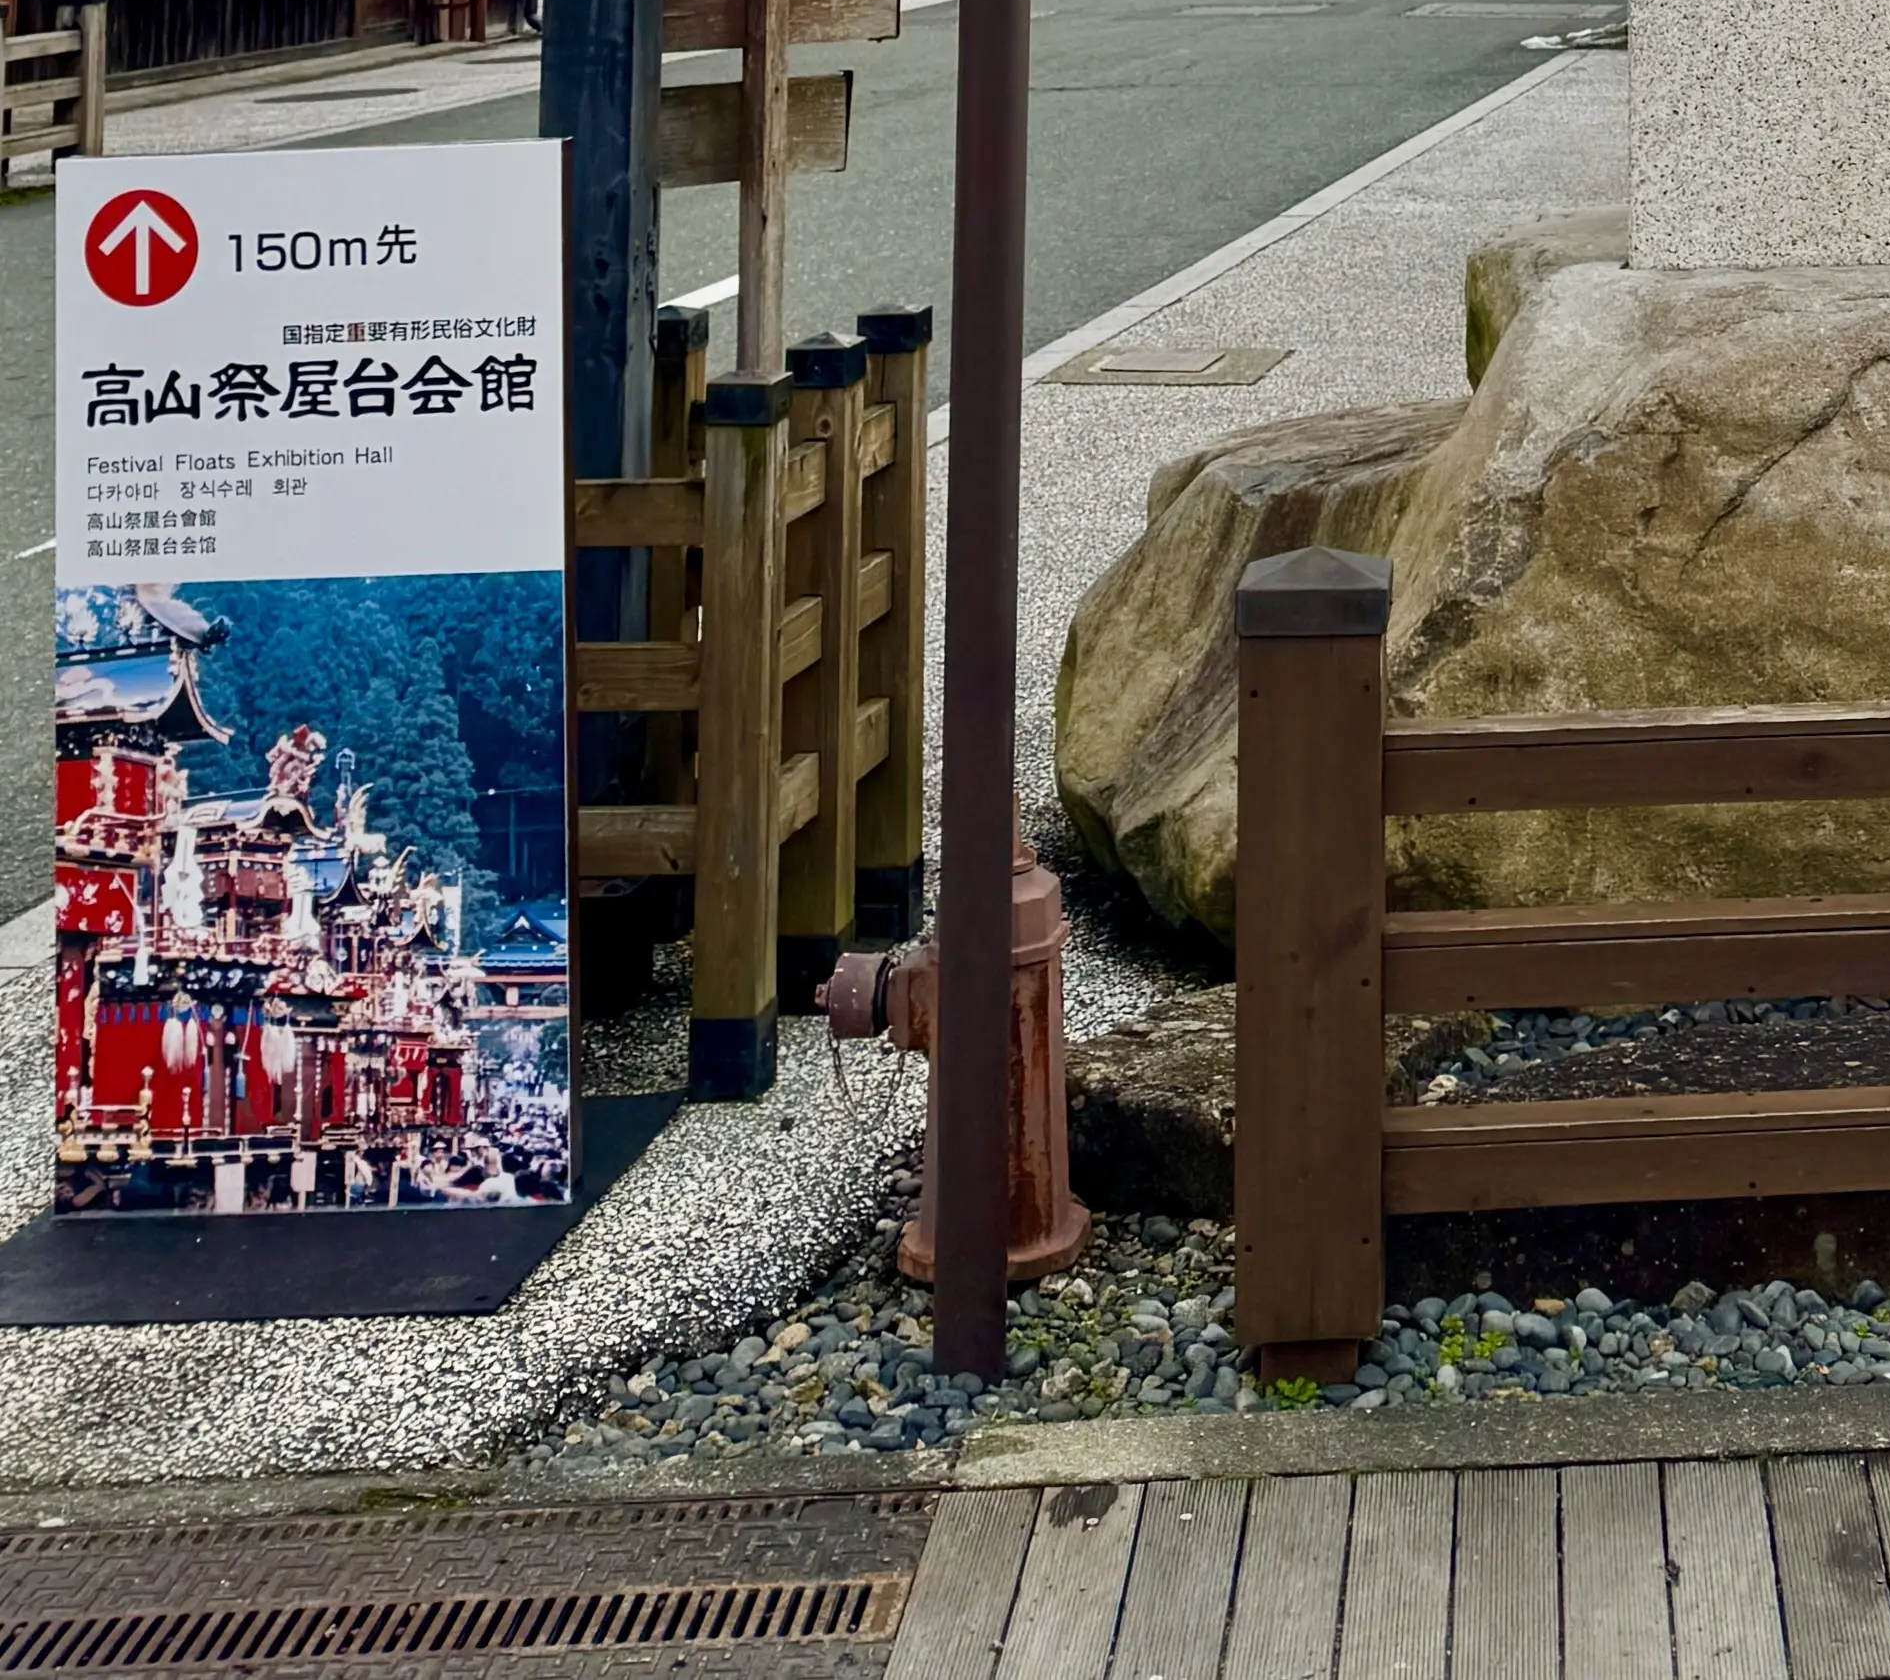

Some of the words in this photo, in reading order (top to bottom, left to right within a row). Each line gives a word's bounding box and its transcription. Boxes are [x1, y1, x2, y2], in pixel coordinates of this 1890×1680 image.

[227, 223, 417, 273] 150m先
[282, 315, 538, 346] 国指定重要有形民俗文化財
[81, 352, 537, 428] 高山祭屋台会館
[87, 455, 163, 474] Festival
[175, 453, 236, 472] Floats
[247, 449, 344, 469] Exhibition
[355, 446, 393, 464] Hall
[86, 482, 161, 503] 다카야마
[179, 478, 253, 500] 장식수레
[272, 476, 308, 497] 회관
[86, 508, 217, 531] 高山祭屋台會館
